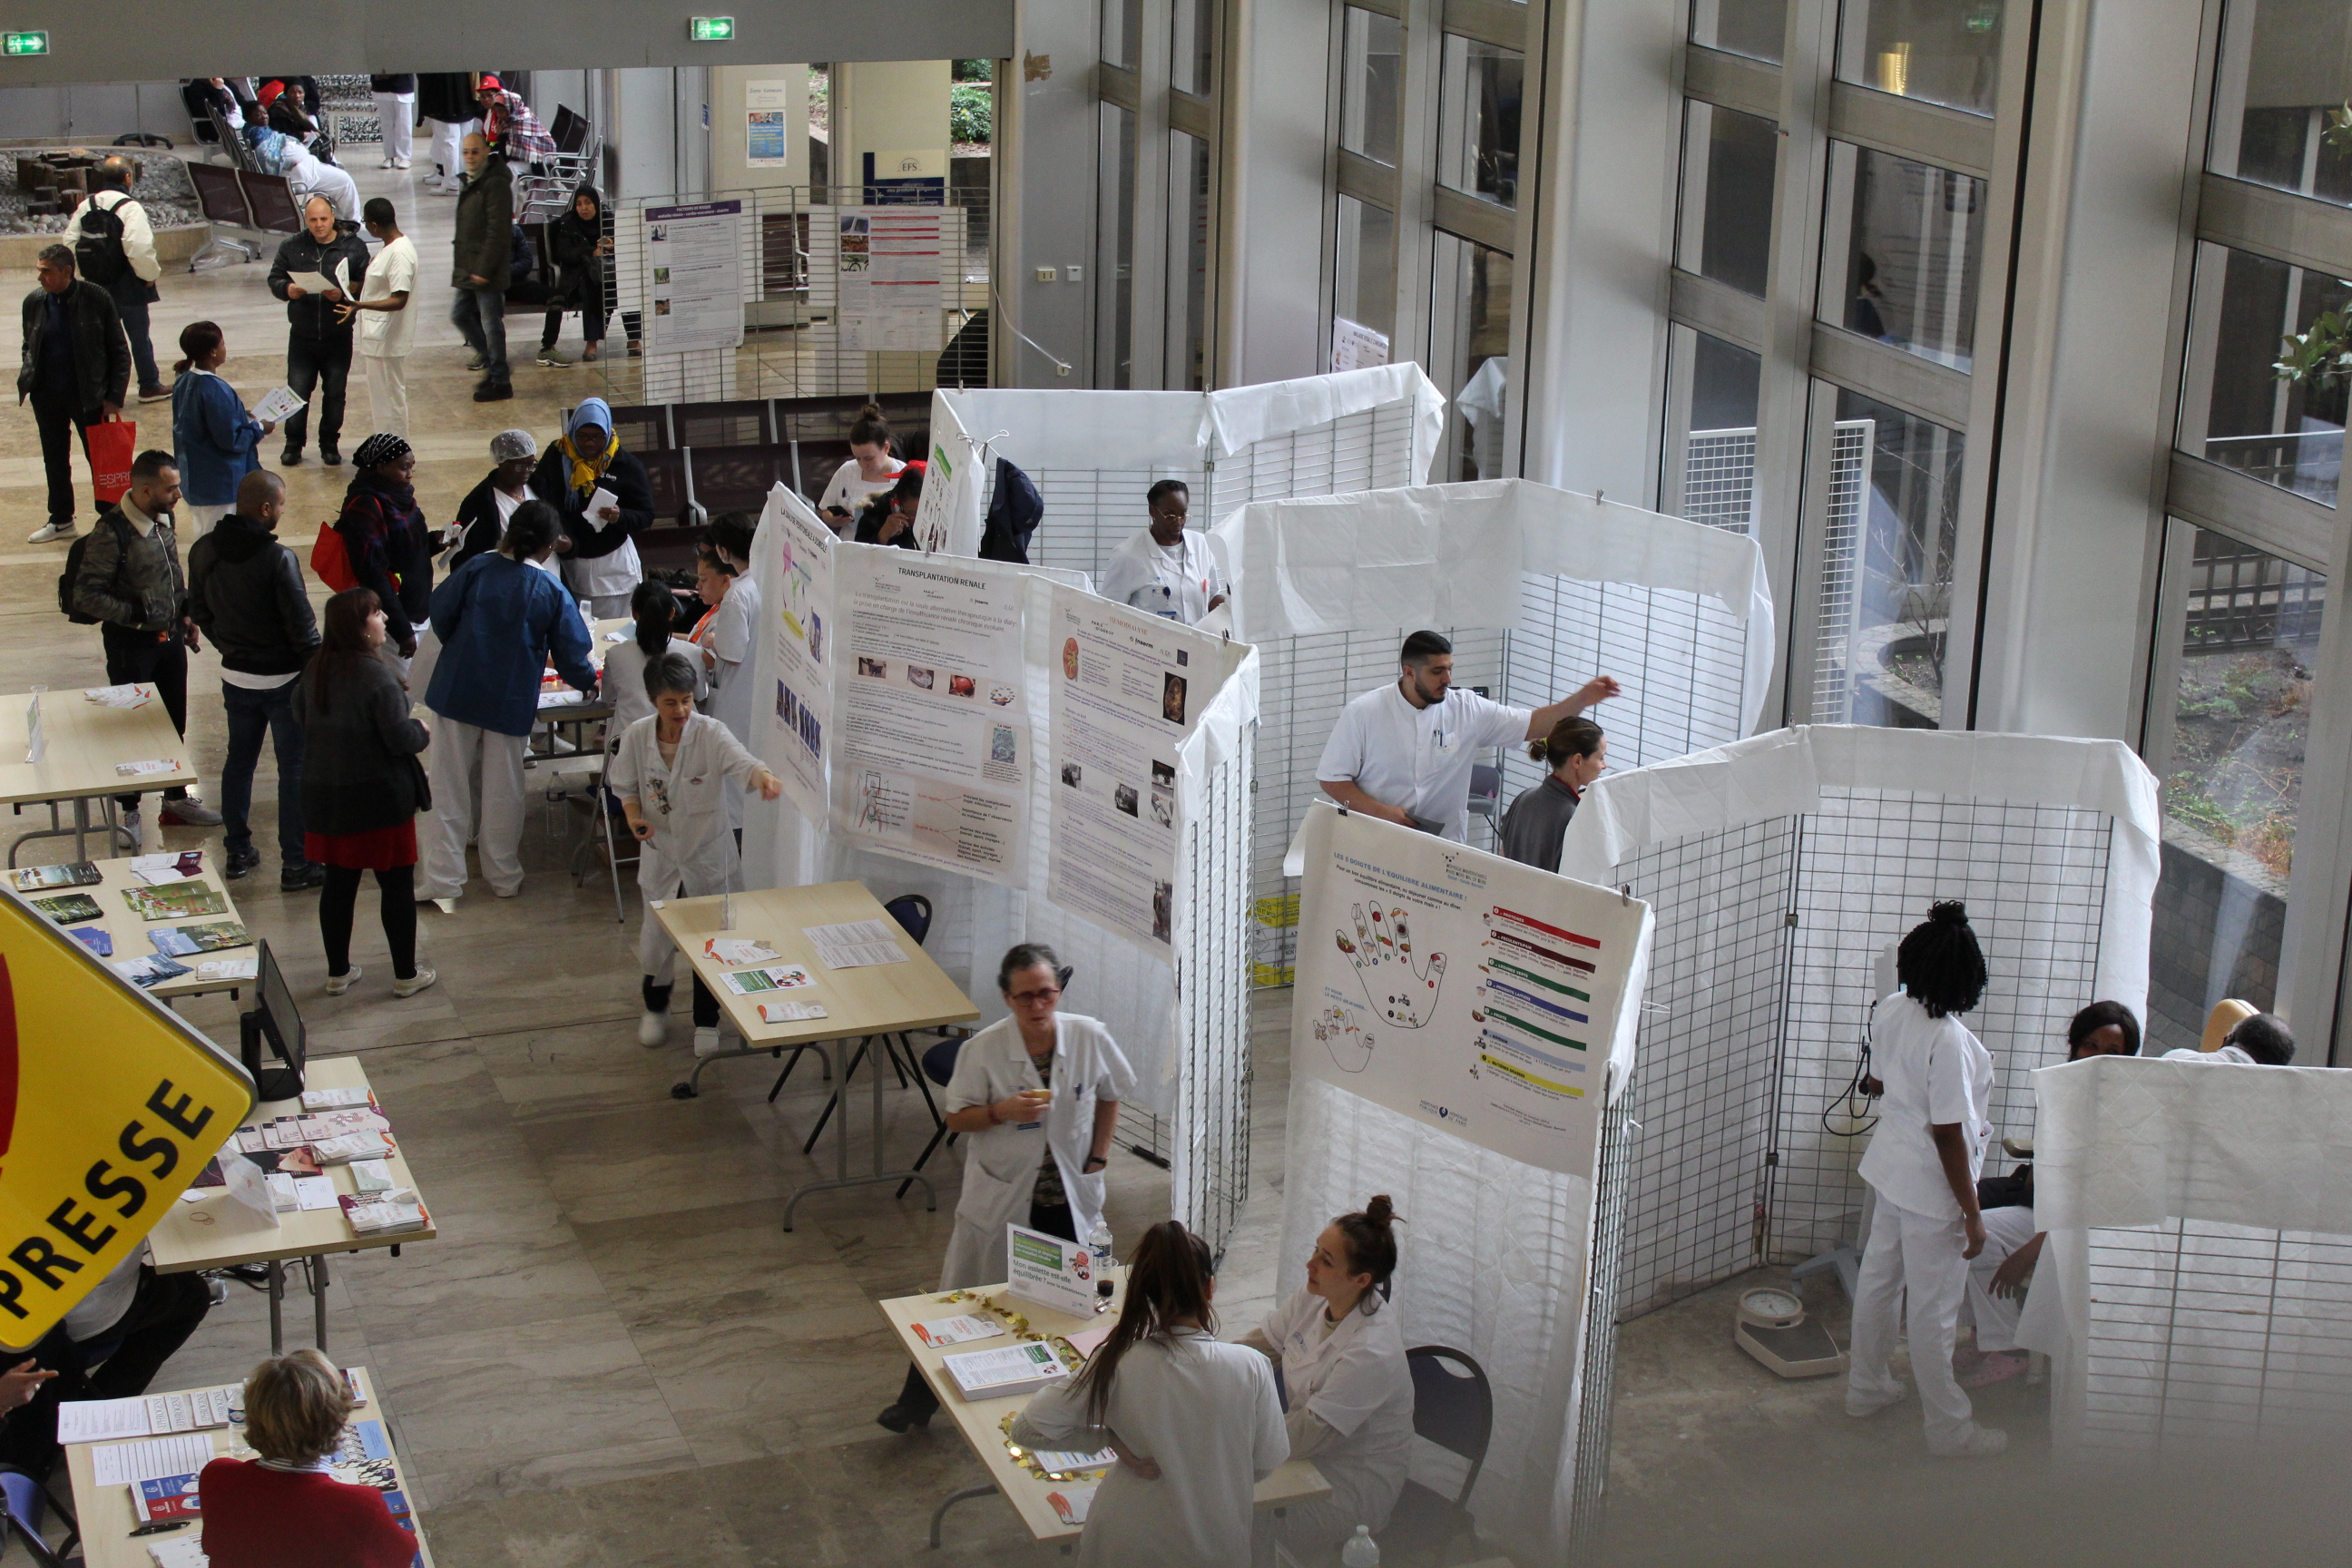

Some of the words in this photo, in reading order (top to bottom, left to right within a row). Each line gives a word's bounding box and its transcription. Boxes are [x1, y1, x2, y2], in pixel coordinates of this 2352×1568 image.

[903, 163, 917, 172] EFS
[100, 472, 131, 485] ESPRI
[898, 567, 959, 585] TRANSPLANTATION
[960, 579, 986, 591] RENALE
[859, 601, 872, 610] prise
[879, 603, 897, 614] charge
[941, 613, 957, 622] rénale
[958, 616, 983, 629] chronique
[862, 593, 900, 605] transplantation
[930, 604, 957, 614] alternative
[957, 609, 993, 623] thérapeutique
[1109, 616, 1148, 635] HEMODIALYSE
[1135, 638, 1153, 649] Inserm
[1334, 852, 1344, 860] LES
[1350, 858, 1371, 871] DOIGTS
[1373, 866, 1381, 874] DE
[1382, 869, 1419, 887] L'EQUILIBRE
[1421, 882, 1463, 900] ALIMENTAIRE
[1359, 871, 1377, 885] équilibre
[1408, 888, 1426, 900] déjeuner
[1427, 896, 1443, 905] comme
[1354, 878, 1378, 891] consommez
[1393, 890, 1406, 900] doigts
[1412, 897, 1423, 906] votre
[1424, 900, 1435, 908] main
[1503, 912, 1524, 923] PROTEINES
[1494, 1013, 1506, 1021] FRUITS
[0, 1077, 215, 1321] PRESSE
[1014, 1259, 1026, 1269] Mon
[1027, 1265, 1051, 1277] assiette
[1051, 1272, 1072, 1284] est-elle
[1014, 1269, 1043, 1282] équilibrée
